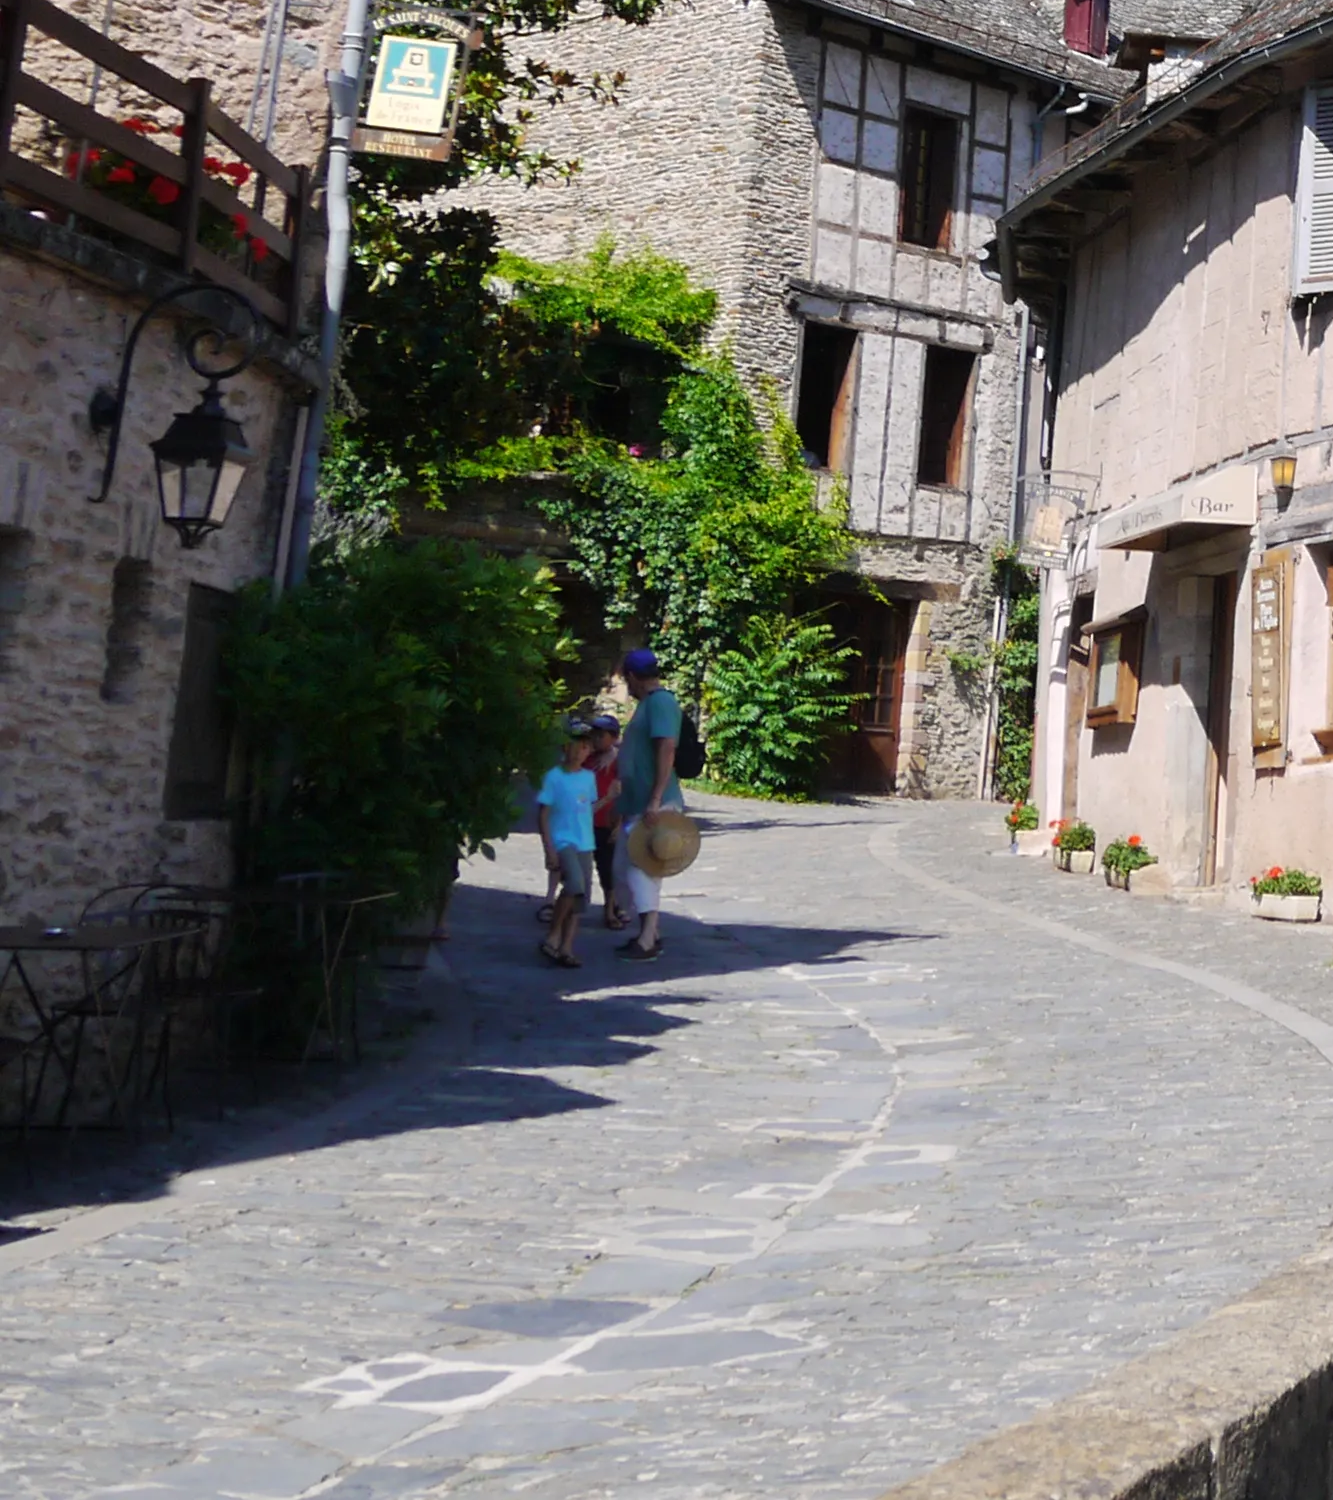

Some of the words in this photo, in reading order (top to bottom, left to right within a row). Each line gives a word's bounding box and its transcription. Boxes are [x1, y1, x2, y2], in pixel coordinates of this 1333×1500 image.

[372, 16, 387, 31] LE
[387, 10, 472, 39] SAINT-JACQUES
[364, 141, 433, 158] RESTAURANT
[1191, 497, 1234, 515] Bar
